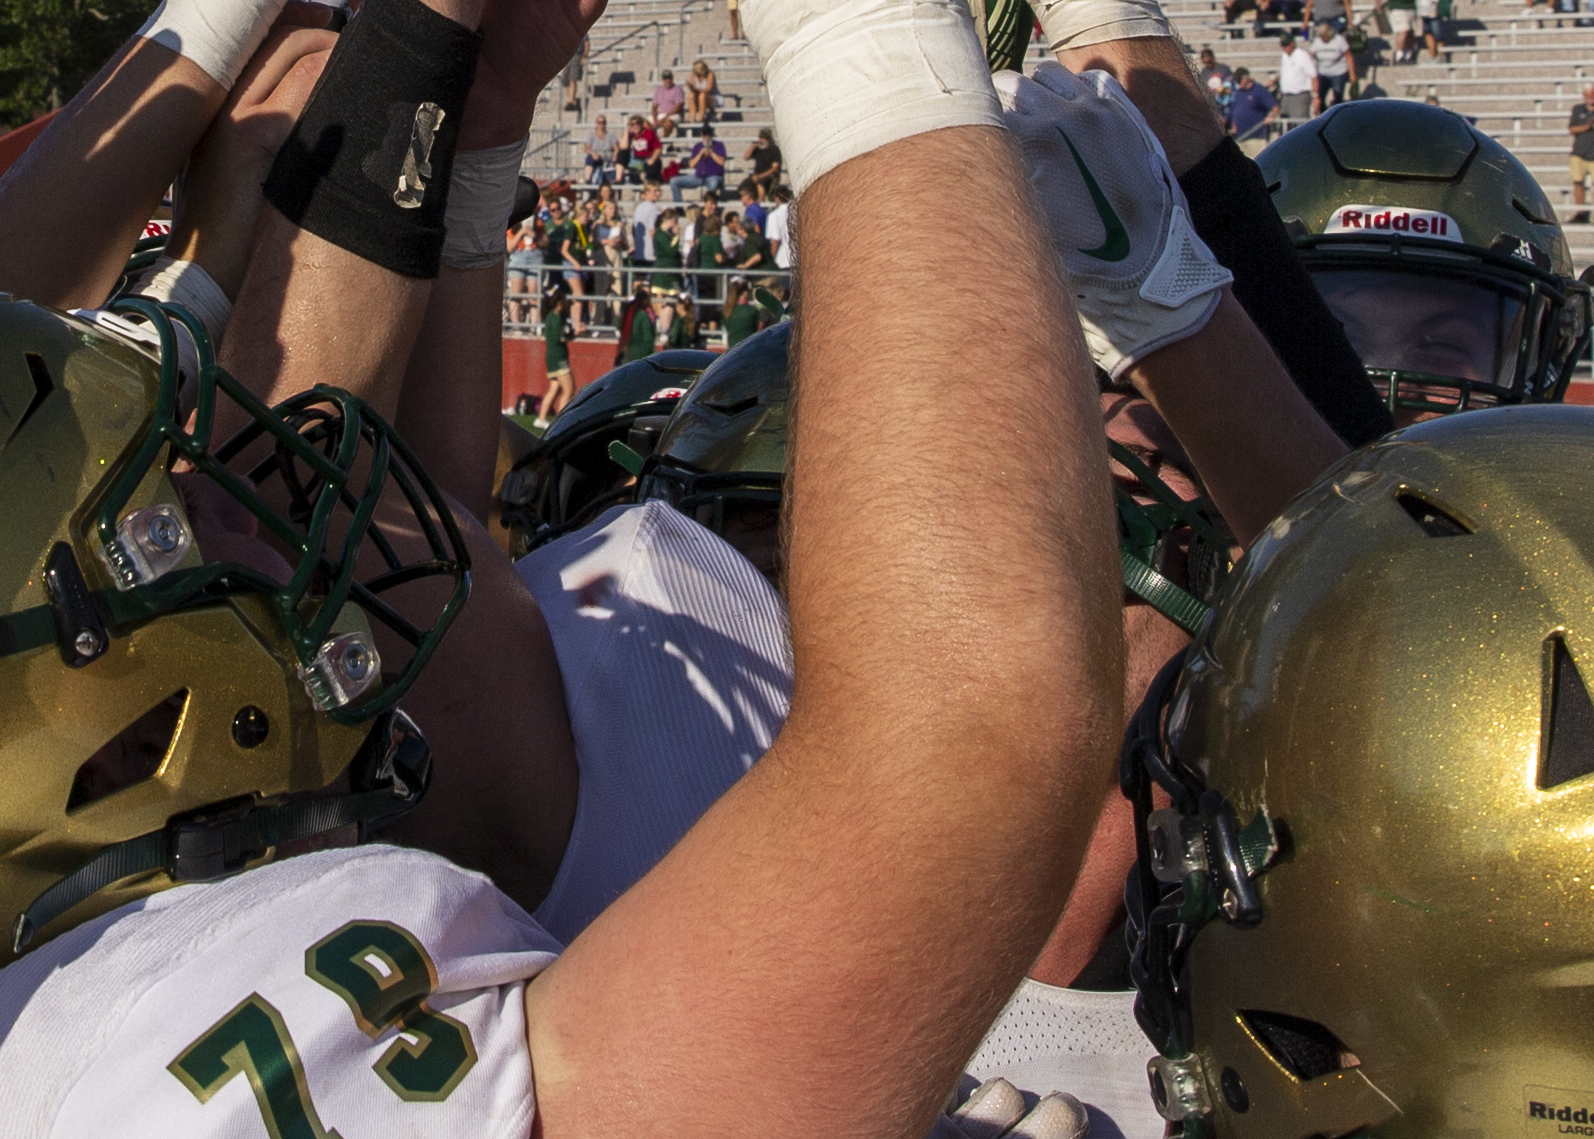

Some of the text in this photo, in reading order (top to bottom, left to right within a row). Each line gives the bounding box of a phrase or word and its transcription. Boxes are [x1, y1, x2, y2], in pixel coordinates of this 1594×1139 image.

[1341, 209, 1448, 236] Riddell
[166, 919, 479, 1139] 79
[1529, 1100, 1594, 1124] Ridd
